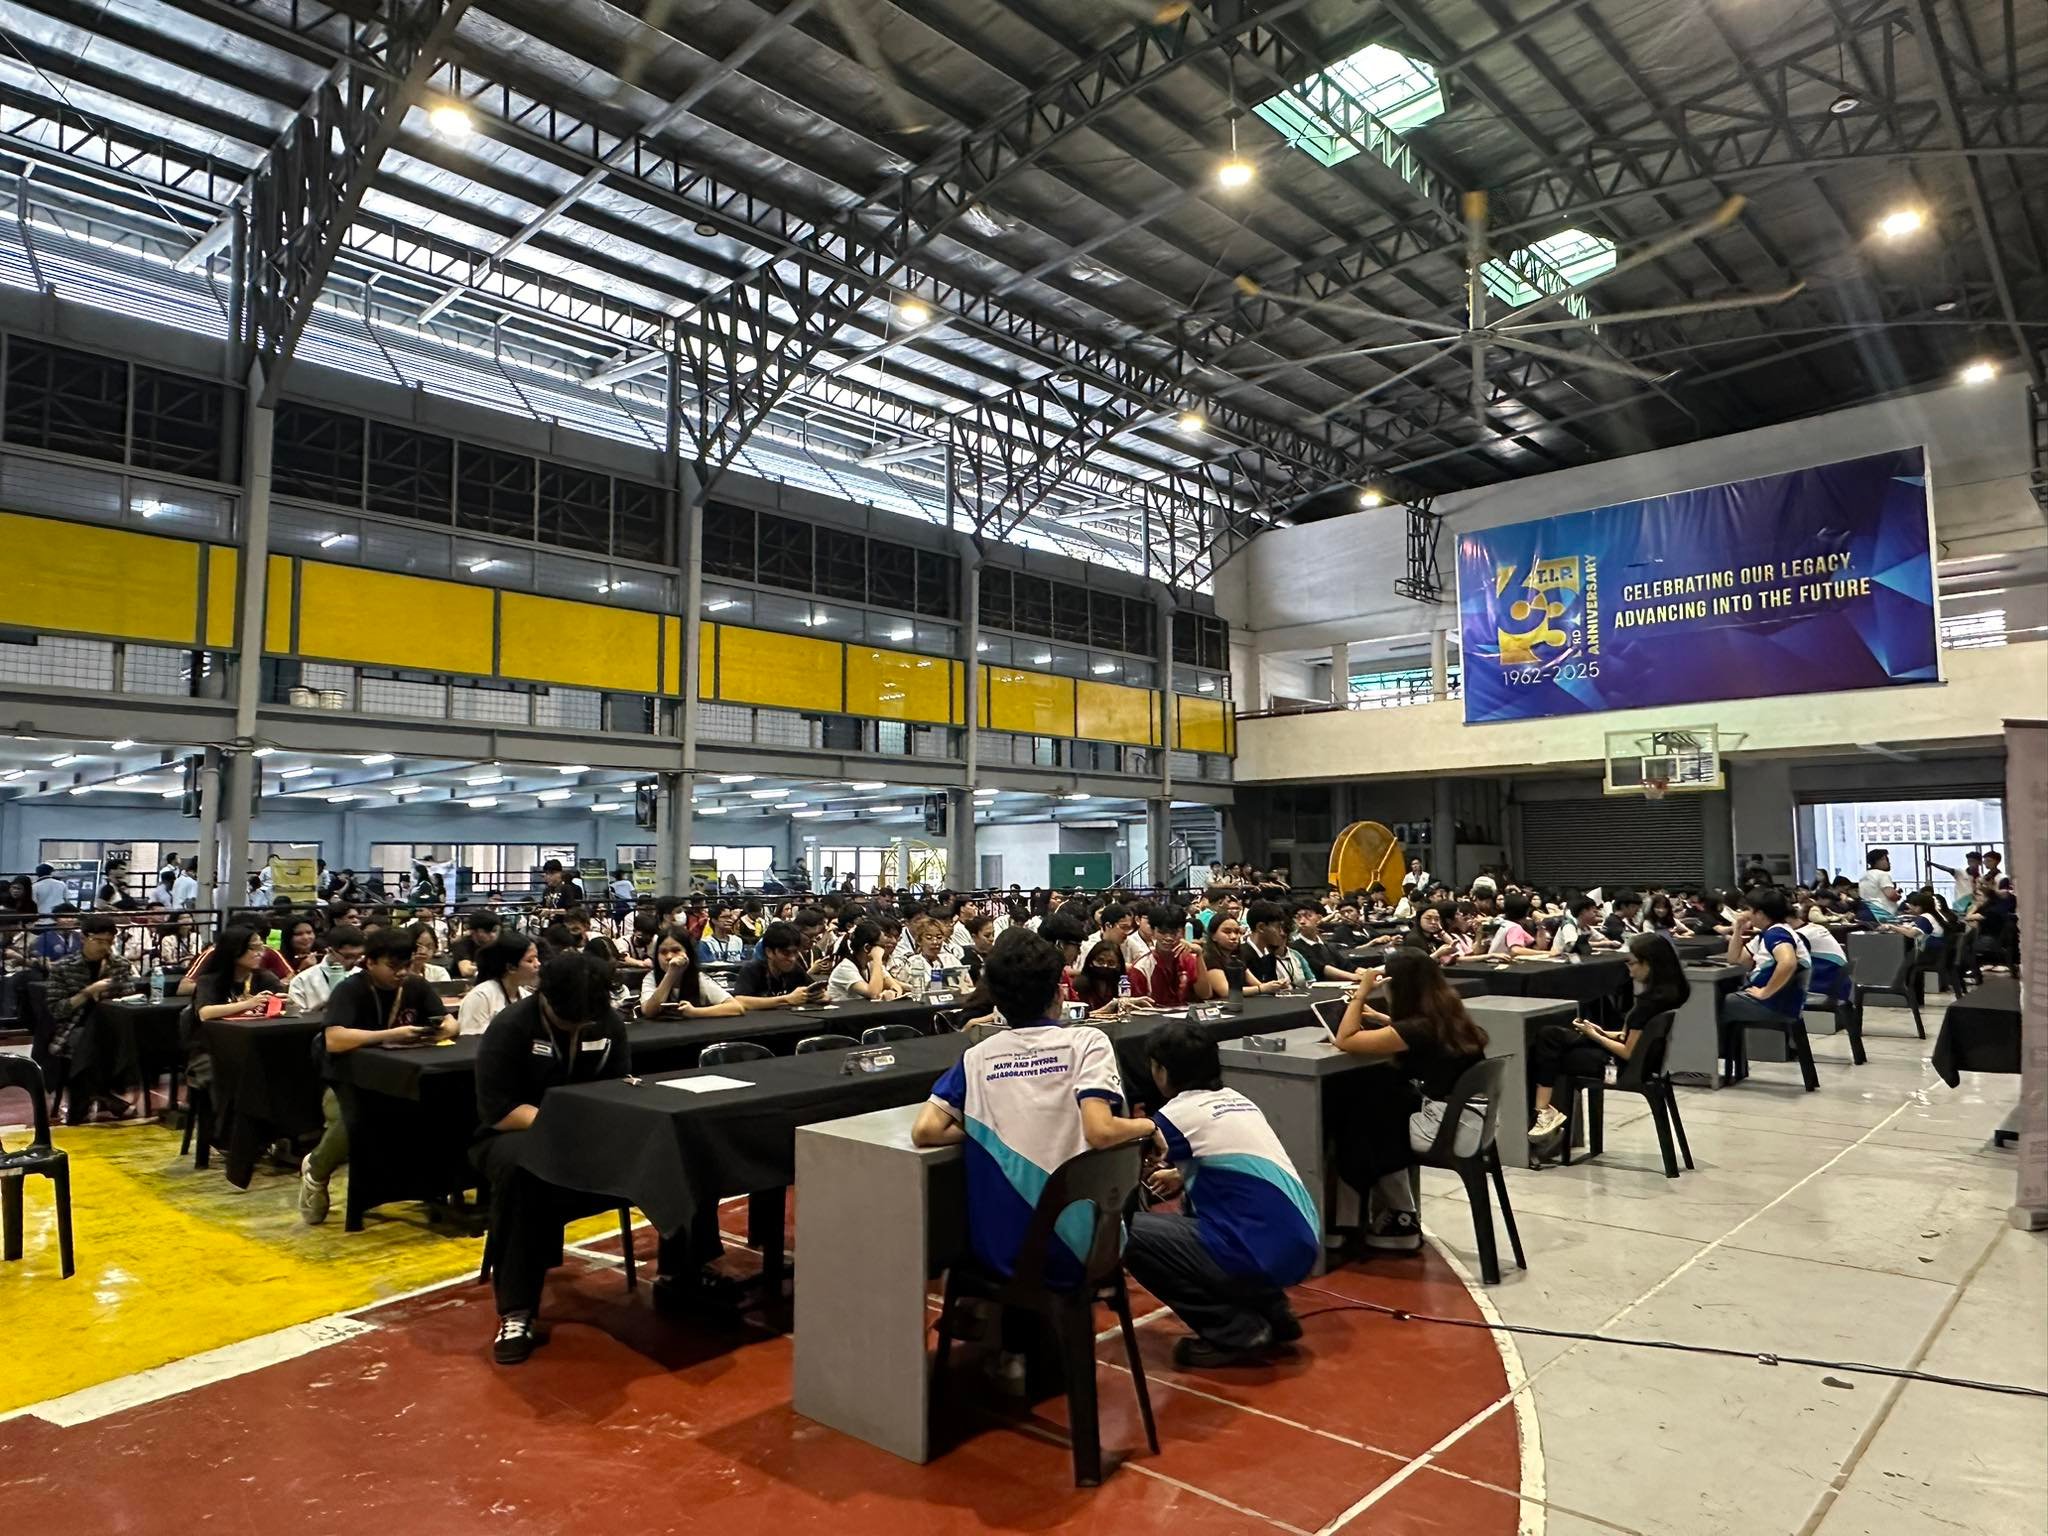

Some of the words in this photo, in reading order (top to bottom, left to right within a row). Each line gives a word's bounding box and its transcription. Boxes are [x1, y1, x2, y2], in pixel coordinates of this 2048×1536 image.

[1536, 566, 1574, 584] T.I.P.
[1623, 570, 1734, 602] CELEBRATING
[1740, 564, 1775, 585] OUR
[1583, 554, 1601, 655] ANNIVERSARY
[1614, 600, 1707, 629] ADVANCING
[1712, 593, 1752, 616] INTO
[1758, 587, 1793, 609] THE
[1799, 576, 1872, 604] FUTURE
[1502, 661, 1601, 686] 1962-2025
